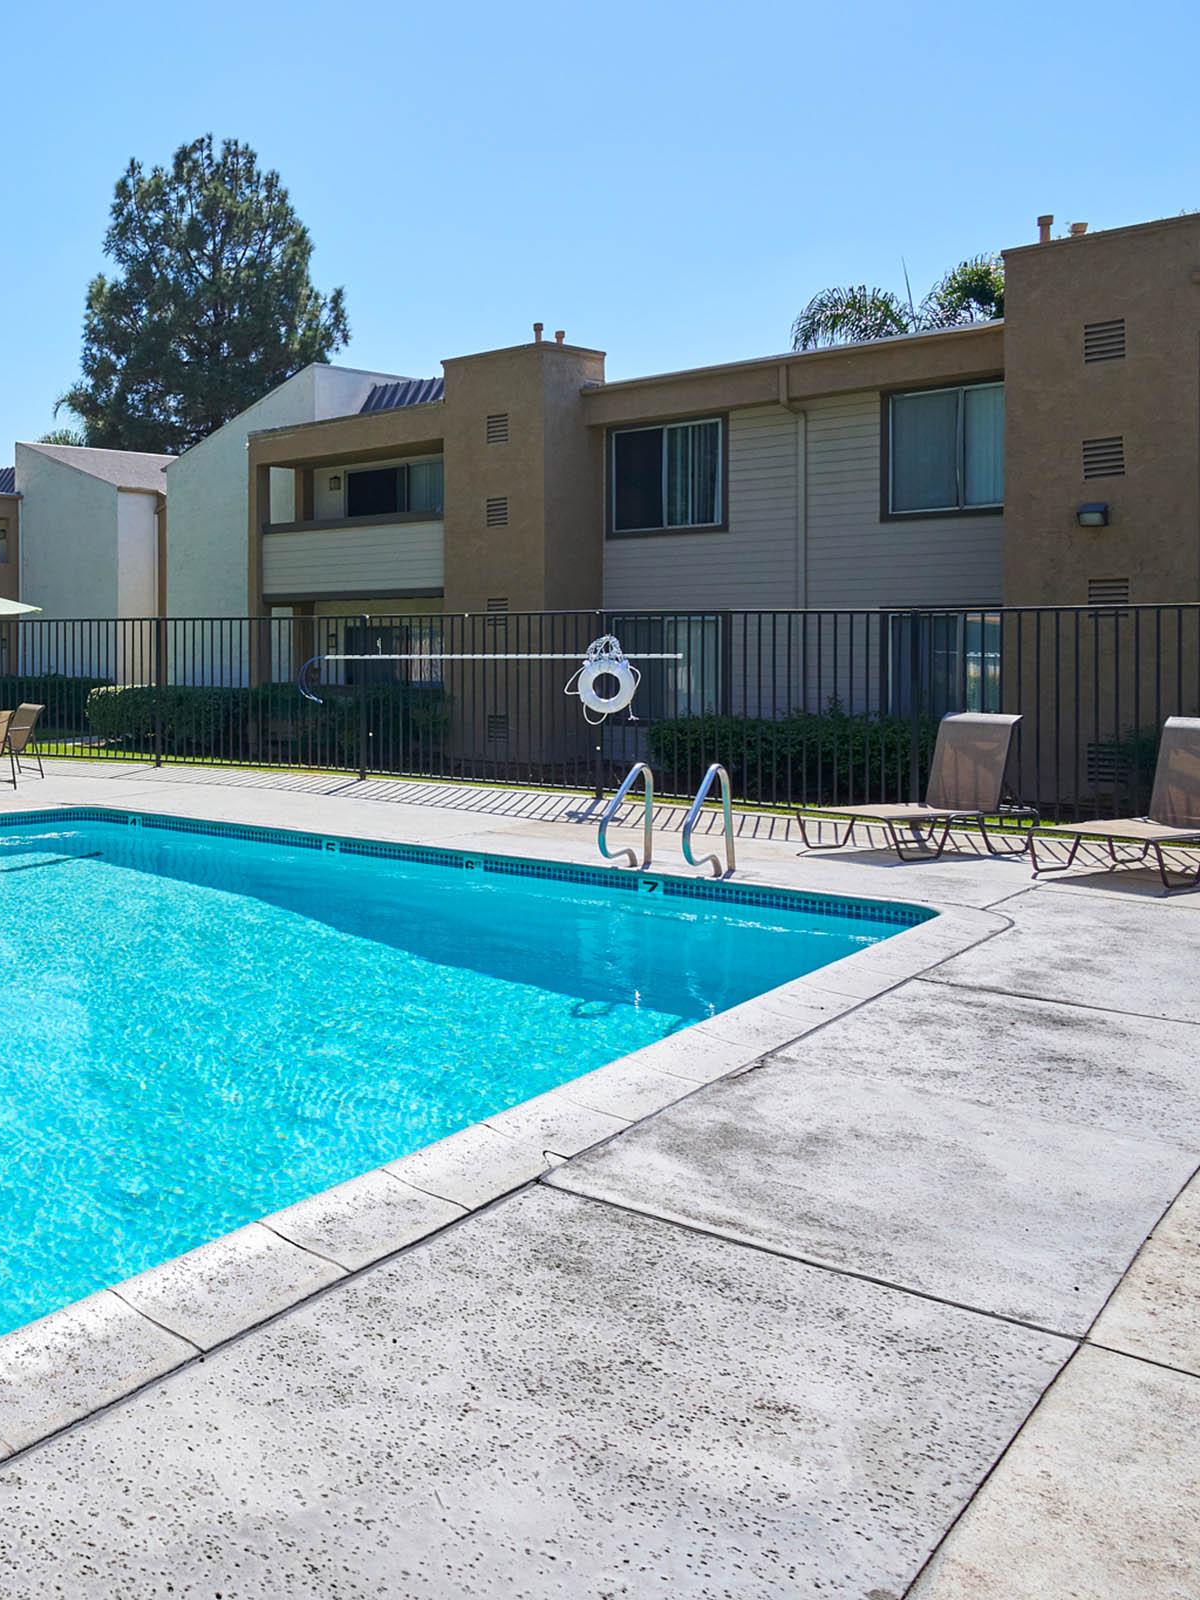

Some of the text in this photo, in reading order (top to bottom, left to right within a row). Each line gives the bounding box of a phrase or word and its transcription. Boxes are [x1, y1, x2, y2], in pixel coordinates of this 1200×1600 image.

[326, 842, 336, 852] 5
[465, 860, 474, 870] 6
[642, 880, 659, 893] 7
